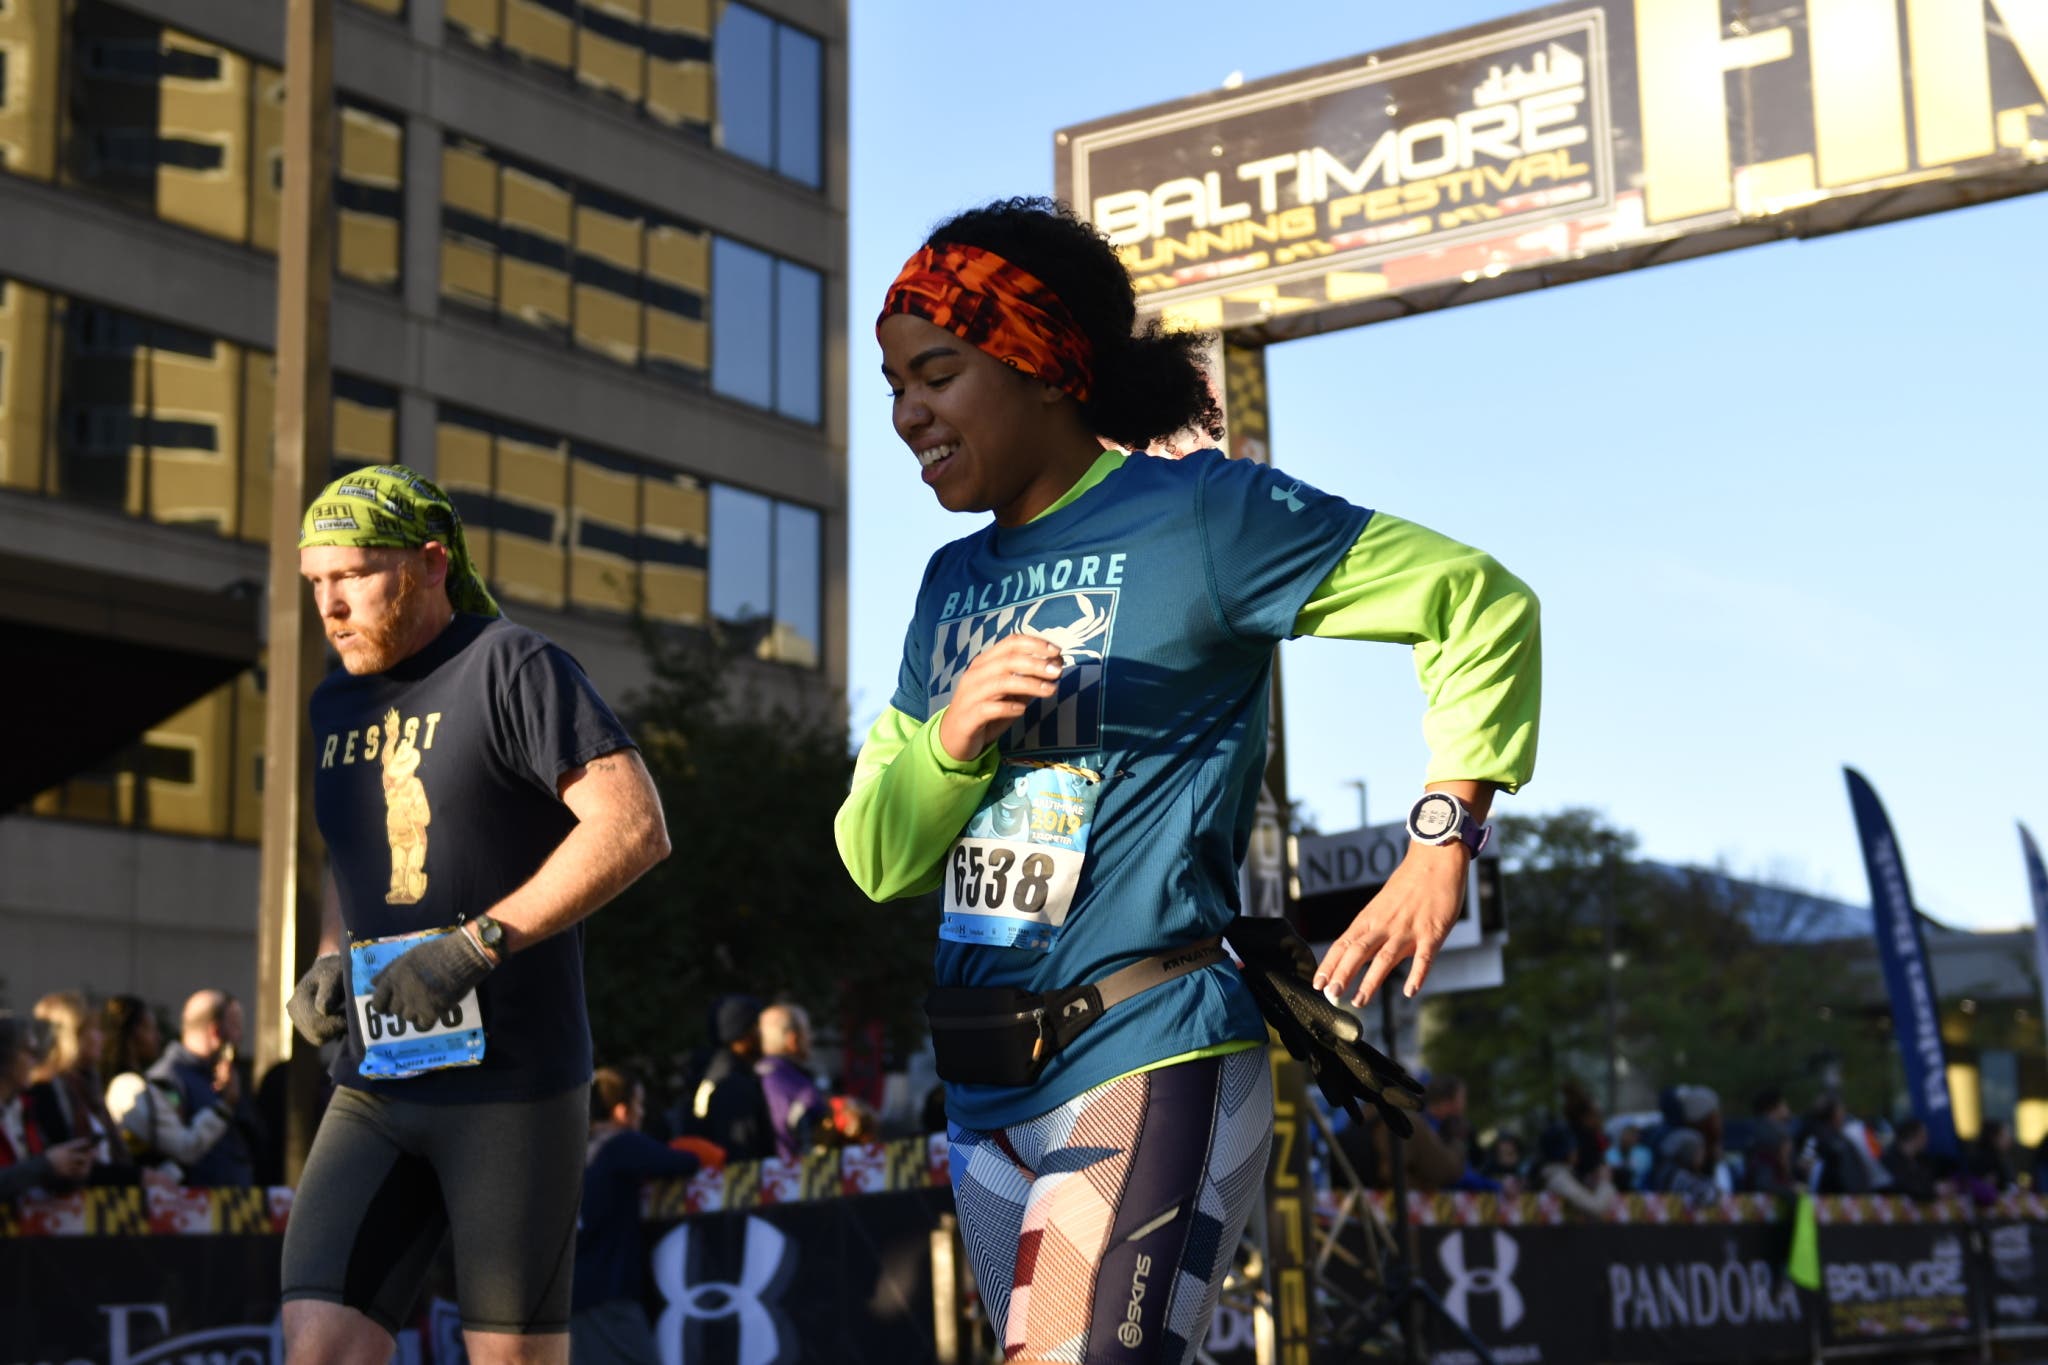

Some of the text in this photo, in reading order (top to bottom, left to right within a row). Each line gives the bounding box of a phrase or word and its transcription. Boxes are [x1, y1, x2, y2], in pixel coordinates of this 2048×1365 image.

[1093, 85, 1589, 247] BALTIMORE
[1116, 149, 1590, 273] UNNING FESTIVAL
[315, 505, 350, 517] LIFE
[941, 553, 1127, 620] BALTIMORE
[1031, 807, 1082, 835] 2019
[953, 844, 1055, 913] 6538
[1127, 1253, 1151, 1323] SKINS
